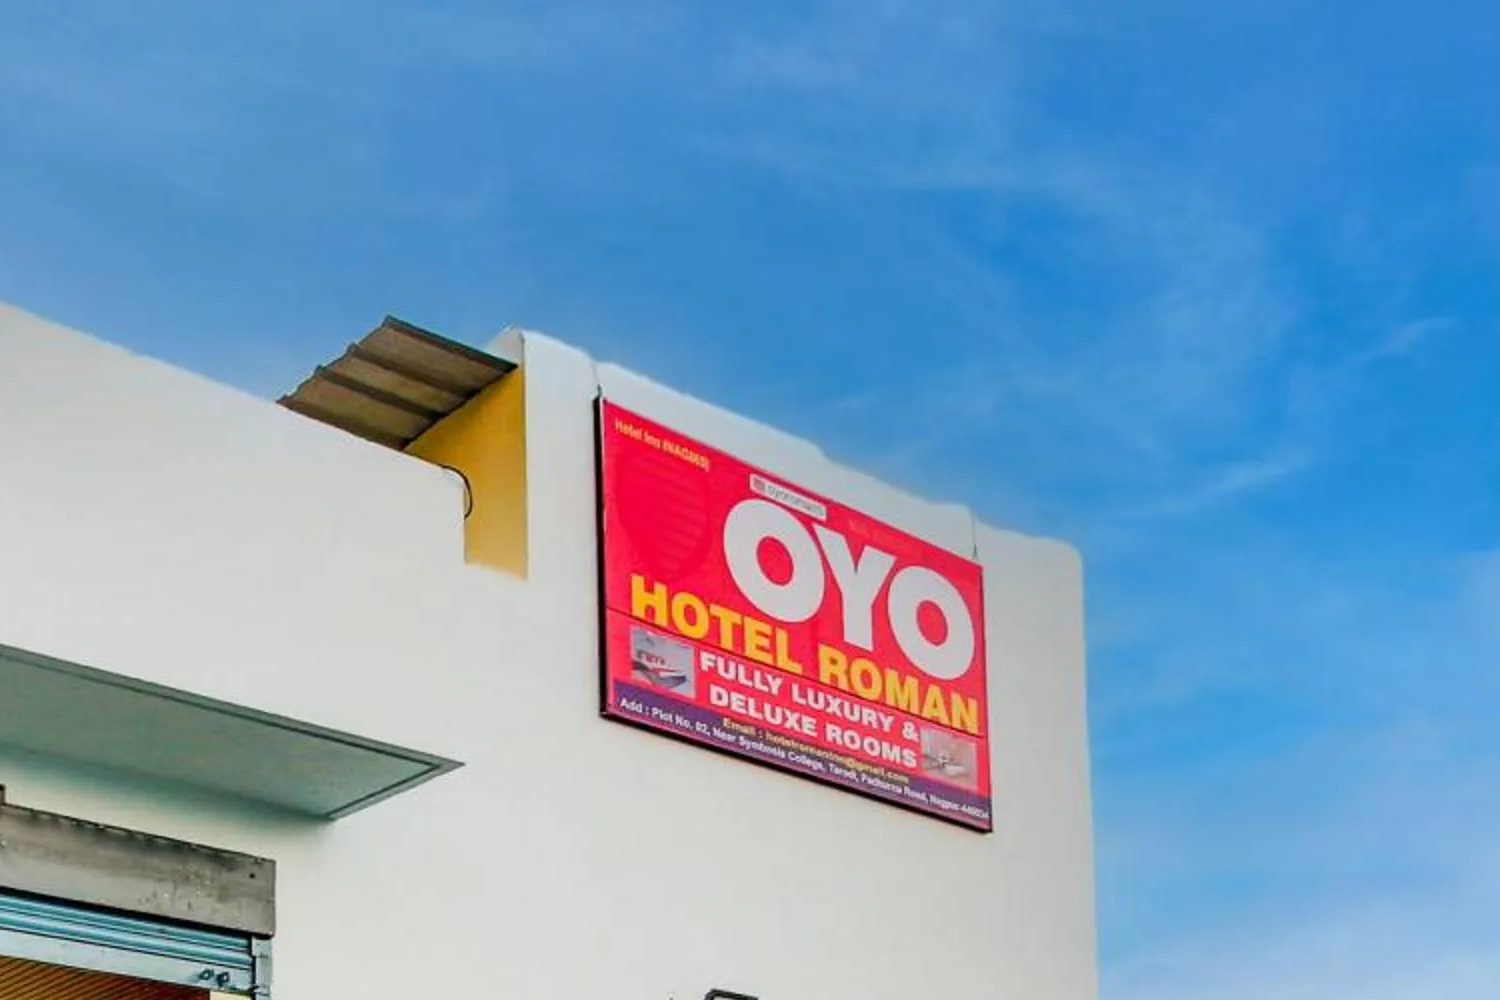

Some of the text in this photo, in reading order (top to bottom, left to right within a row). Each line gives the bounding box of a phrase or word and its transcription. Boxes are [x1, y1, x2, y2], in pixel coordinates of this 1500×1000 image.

[723, 499, 975, 680] OYO
[631, 574, 979, 734] HOTEL ROMAN
[700, 652, 920, 741] FULLY LUXURY &
[620, 698, 642, 714] Add
[651, 707, 672, 722] Plot
[713, 727, 736, 742] Near
[709, 685, 917, 768] DELUXE ROOMS
